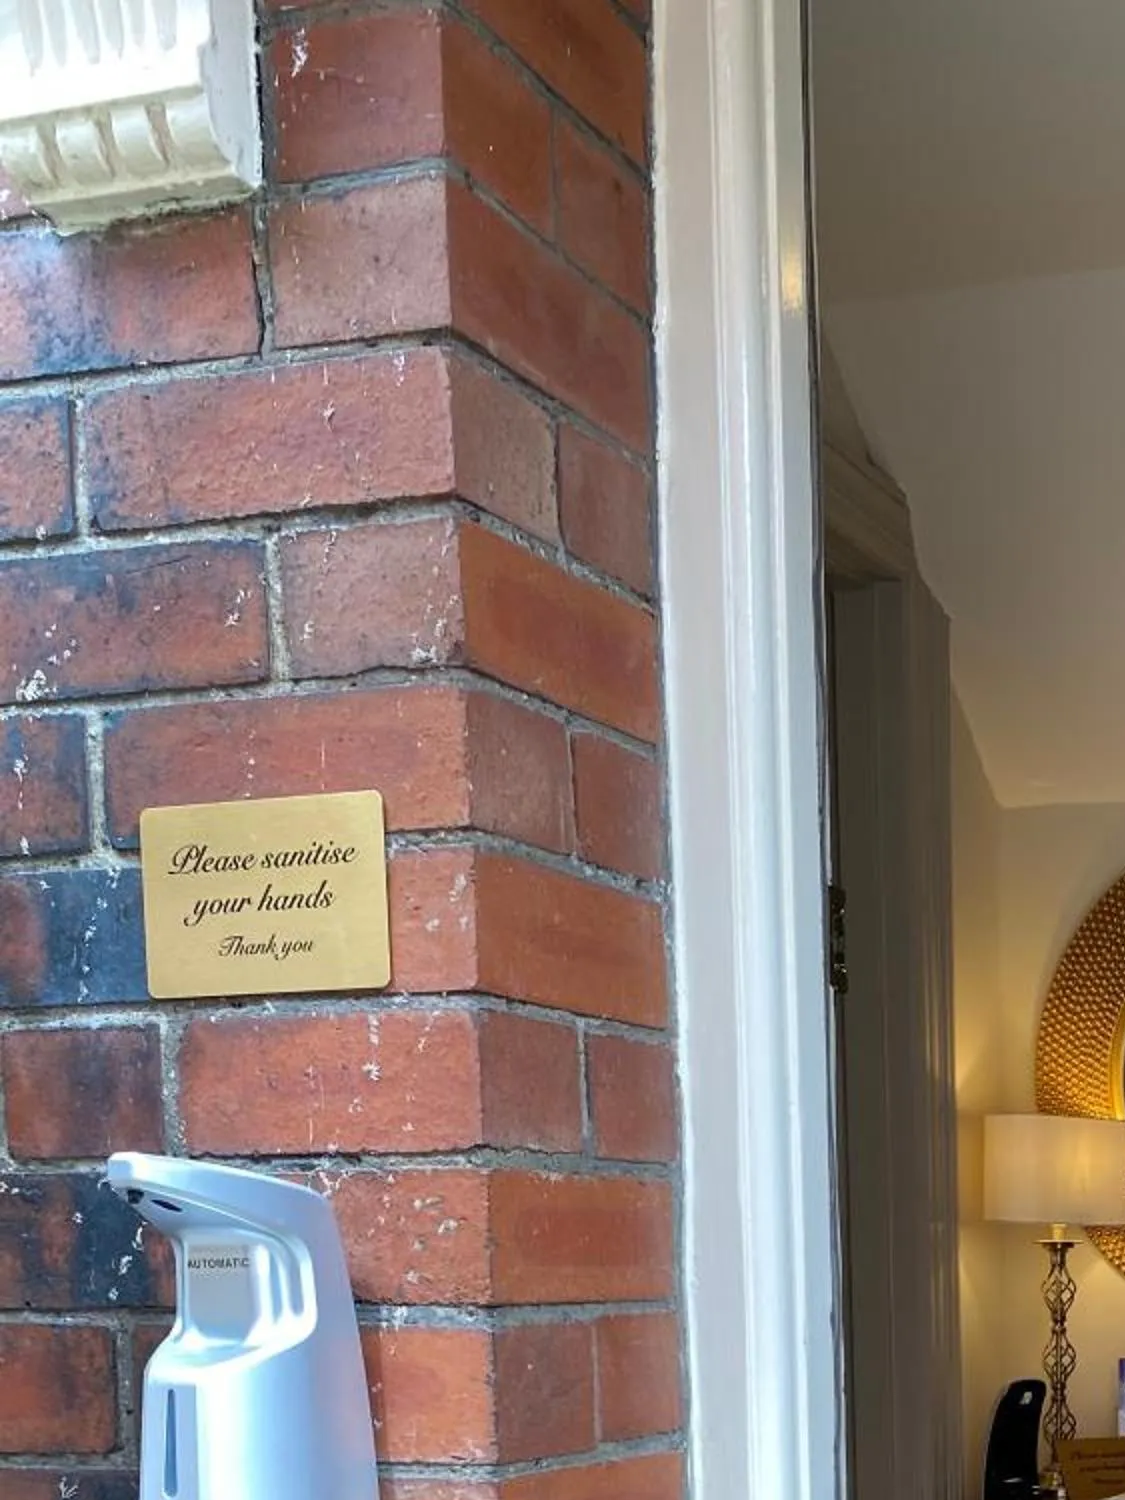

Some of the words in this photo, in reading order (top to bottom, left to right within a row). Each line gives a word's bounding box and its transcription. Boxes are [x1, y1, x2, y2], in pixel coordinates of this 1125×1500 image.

[168, 844, 257, 875] Please
[260, 840, 356, 869] sanitise
[183, 896, 251, 927] your
[257, 880, 334, 912] hands
[218, 934, 277, 957] Thank
[274, 938, 314, 960] you
[188, 1257, 250, 1269] AUTOMATIC
